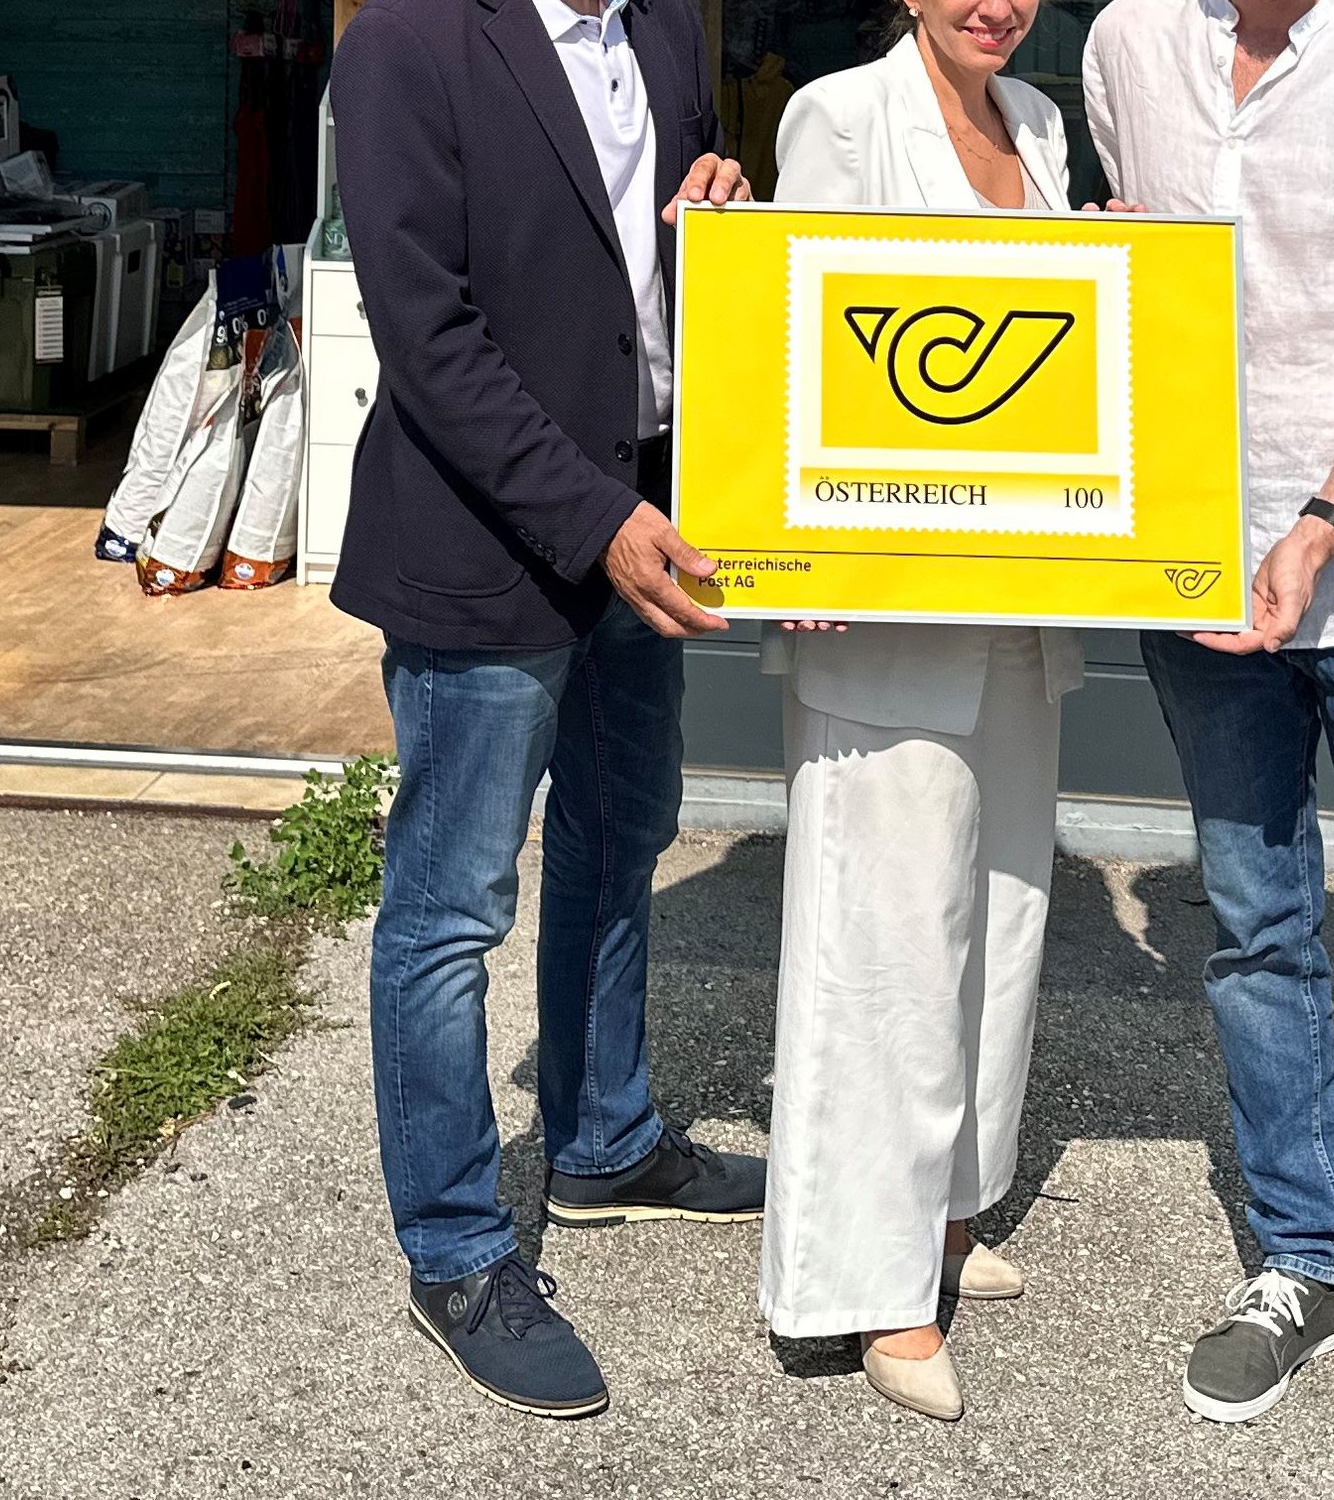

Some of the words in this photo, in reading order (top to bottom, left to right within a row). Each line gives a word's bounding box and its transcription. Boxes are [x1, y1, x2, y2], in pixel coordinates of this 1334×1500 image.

[814, 475, 988, 506] ÖSTERREICH
[1063, 487, 1104, 509] 100
[714, 557, 812, 573] terreichische
[733, 575, 756, 588] AG
